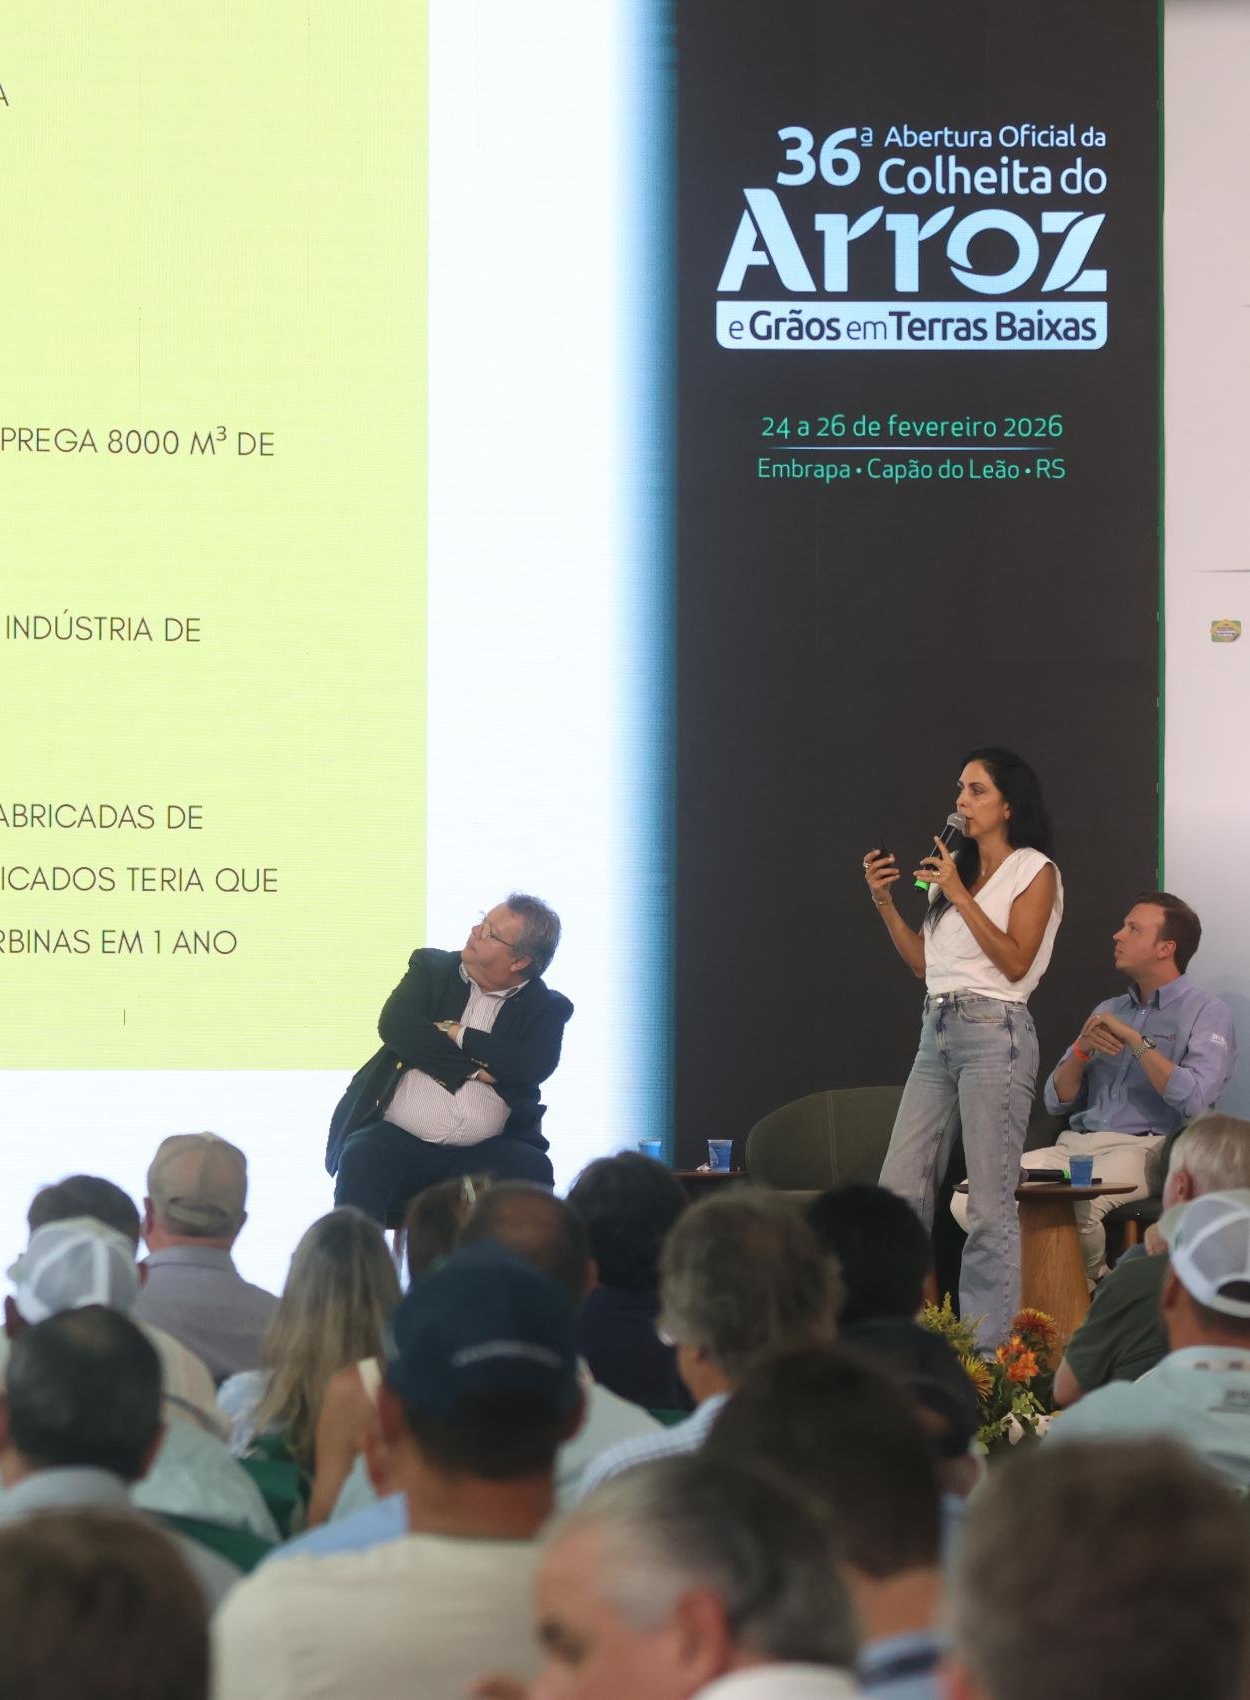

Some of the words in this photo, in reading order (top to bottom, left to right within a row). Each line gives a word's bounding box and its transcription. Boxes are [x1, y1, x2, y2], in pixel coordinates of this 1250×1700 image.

[884, 124, 992, 147] Abertura
[999, 124, 1076, 147] Oficial
[1081, 126, 1106, 146] da
[879, 155, 1051, 194] Colheita
[1060, 157, 1107, 194] do
[717, 188, 1107, 294] Arroz
[730, 321, 743, 339] e
[750, 310, 841, 340] Grãos
[847, 321, 887, 340] em
[888, 311, 987, 341] Terras
[996, 309, 1096, 341] Baixas
[762, 416, 790, 439] 24
[798, 421, 809, 436] a
[817, 414, 846, 436] 26
[853, 415, 880, 436] de
[888, 414, 996, 437] fevereiro
[1004, 414, 1062, 437] 2026
[108, 429, 179, 454] 8000
[238, 432, 274, 456] DE
[758, 458, 850, 484] Embrapa
[868, 458, 932, 484] Capão
[938, 459, 963, 478] do
[970, 459, 1019, 479] Leão
[1037, 458, 1065, 478] RS
[7, 609, 153, 641] INDÚSTRIA
[165, 617, 200, 642] DE
[168, 805, 202, 829] DE
[126, 867, 204, 892] TERIA
[216, 868, 278, 892] QUE
[102, 929, 143, 954] EM
[172, 930, 237, 954] ANO
